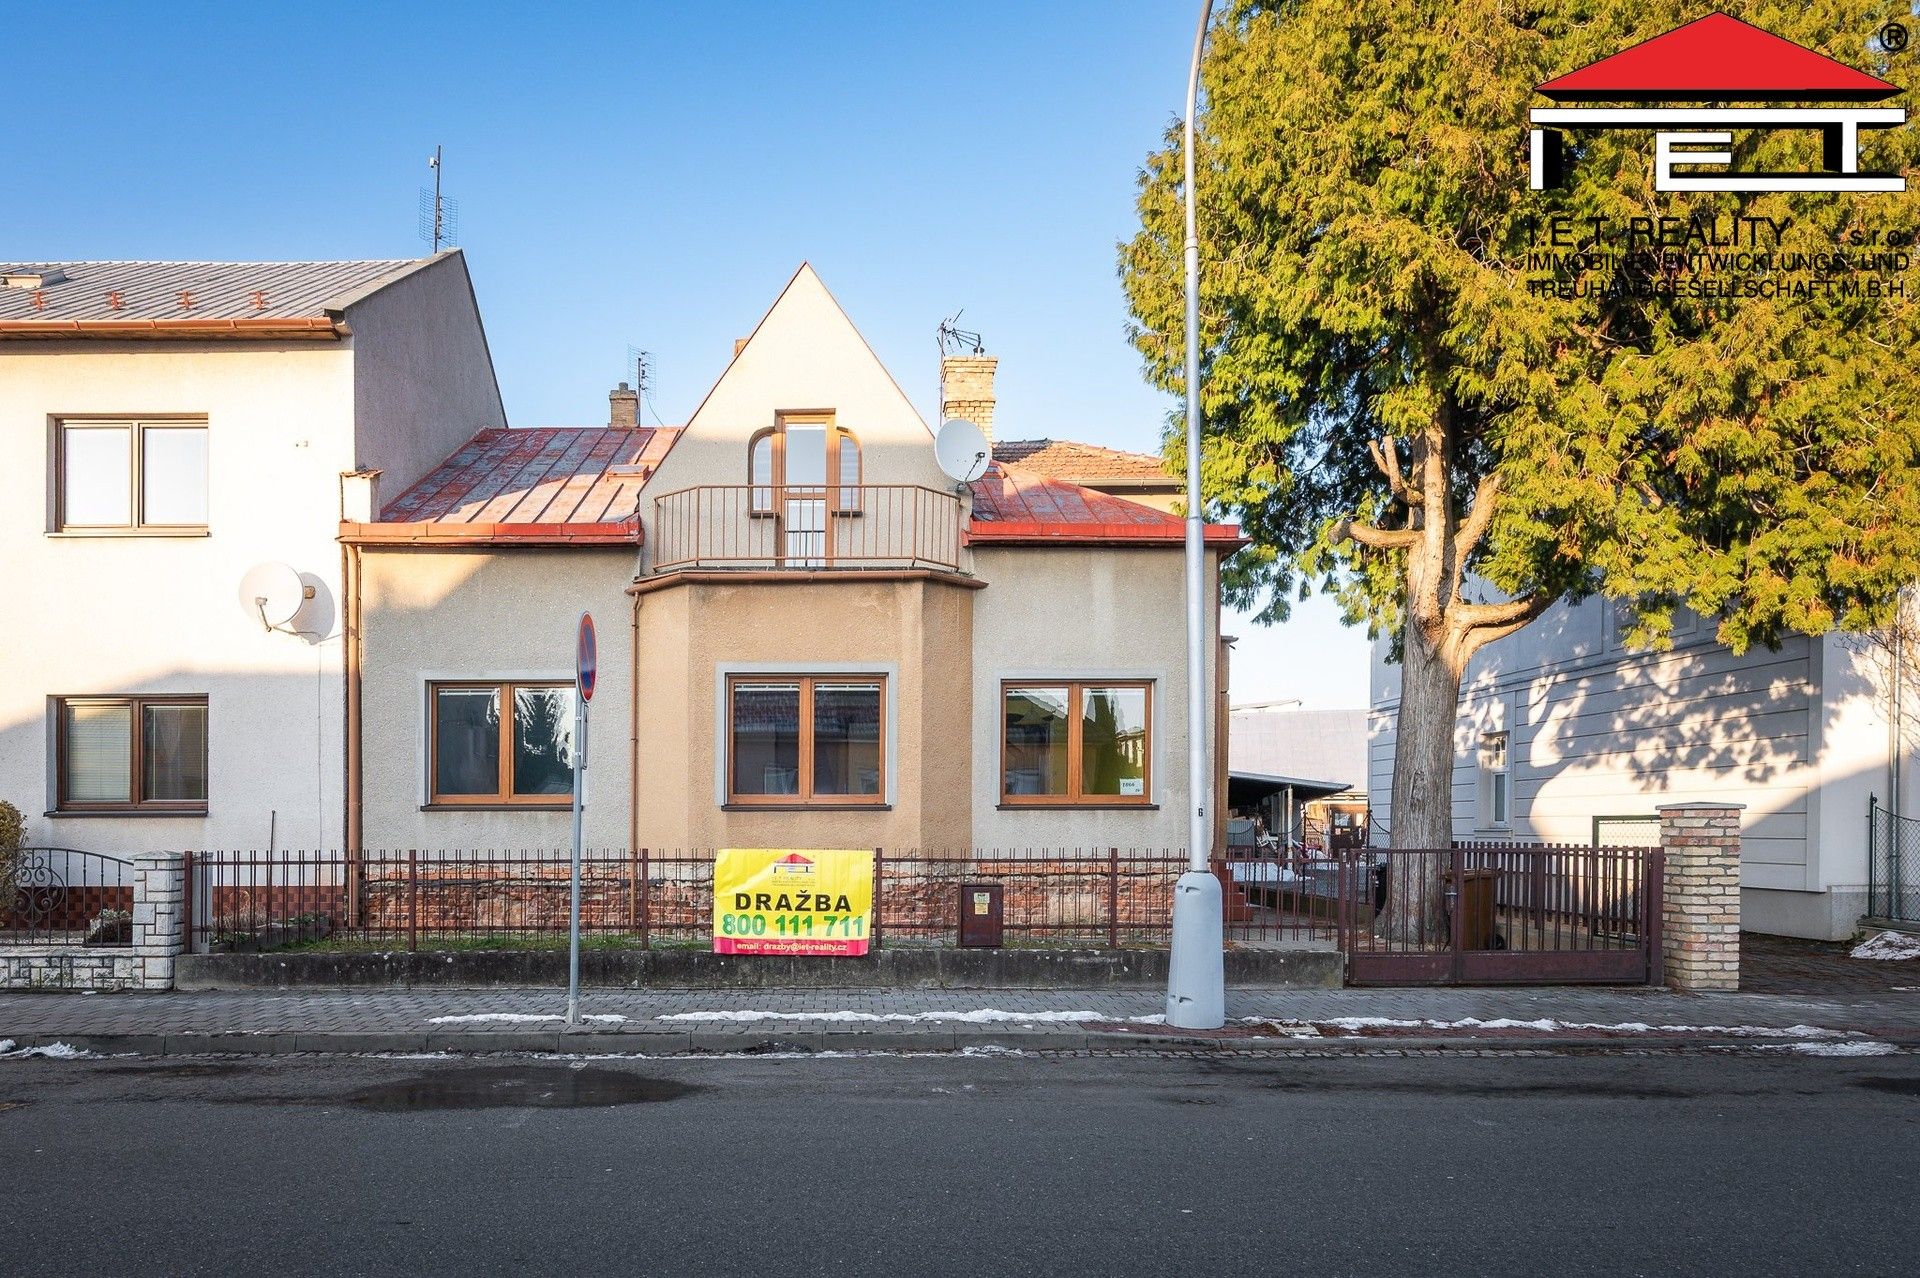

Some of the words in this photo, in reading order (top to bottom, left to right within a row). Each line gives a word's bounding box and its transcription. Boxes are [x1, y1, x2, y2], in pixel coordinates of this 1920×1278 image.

[1198, 808, 1204, 817] 6
[735, 890, 852, 912] DRAŽBA
[722, 914, 766, 935] 800
[775, 914, 813, 936] 111
[824, 915, 864, 937] 711
[763, 943, 848, 952] drazby@iet-reality.cz
